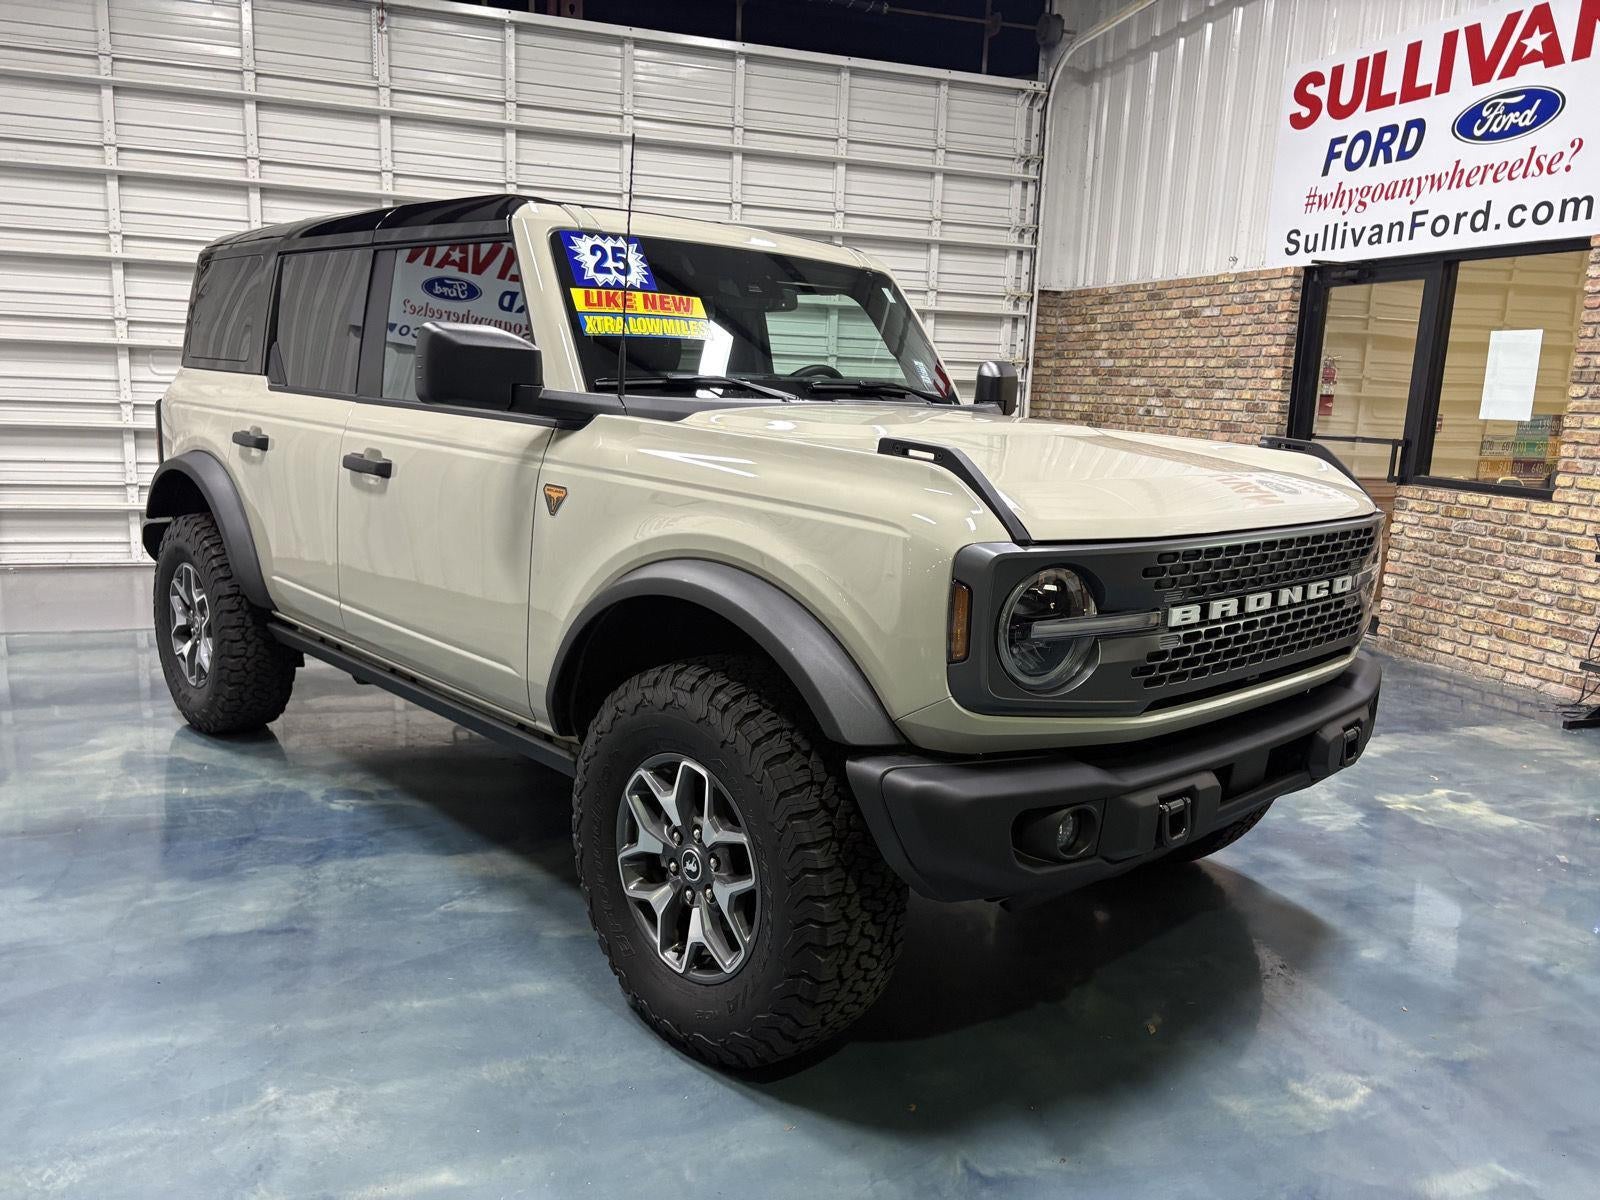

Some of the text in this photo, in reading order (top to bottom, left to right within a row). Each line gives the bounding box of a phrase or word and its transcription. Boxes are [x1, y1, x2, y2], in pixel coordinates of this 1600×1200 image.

[1473, 94, 1542, 136] Ford
[1321, 118, 1427, 177] FORD
[1303, 137, 1584, 215] #whygoanywhereelse?
[1284, 195, 1594, 256] SullivanFord.com
[589, 243, 632, 277] 25
[584, 290, 693, 315] LIKE NEW
[584, 315, 629, 335] XTRA
[629, 317, 663, 336] LOW
[1167, 575, 1353, 628] BRONCO
